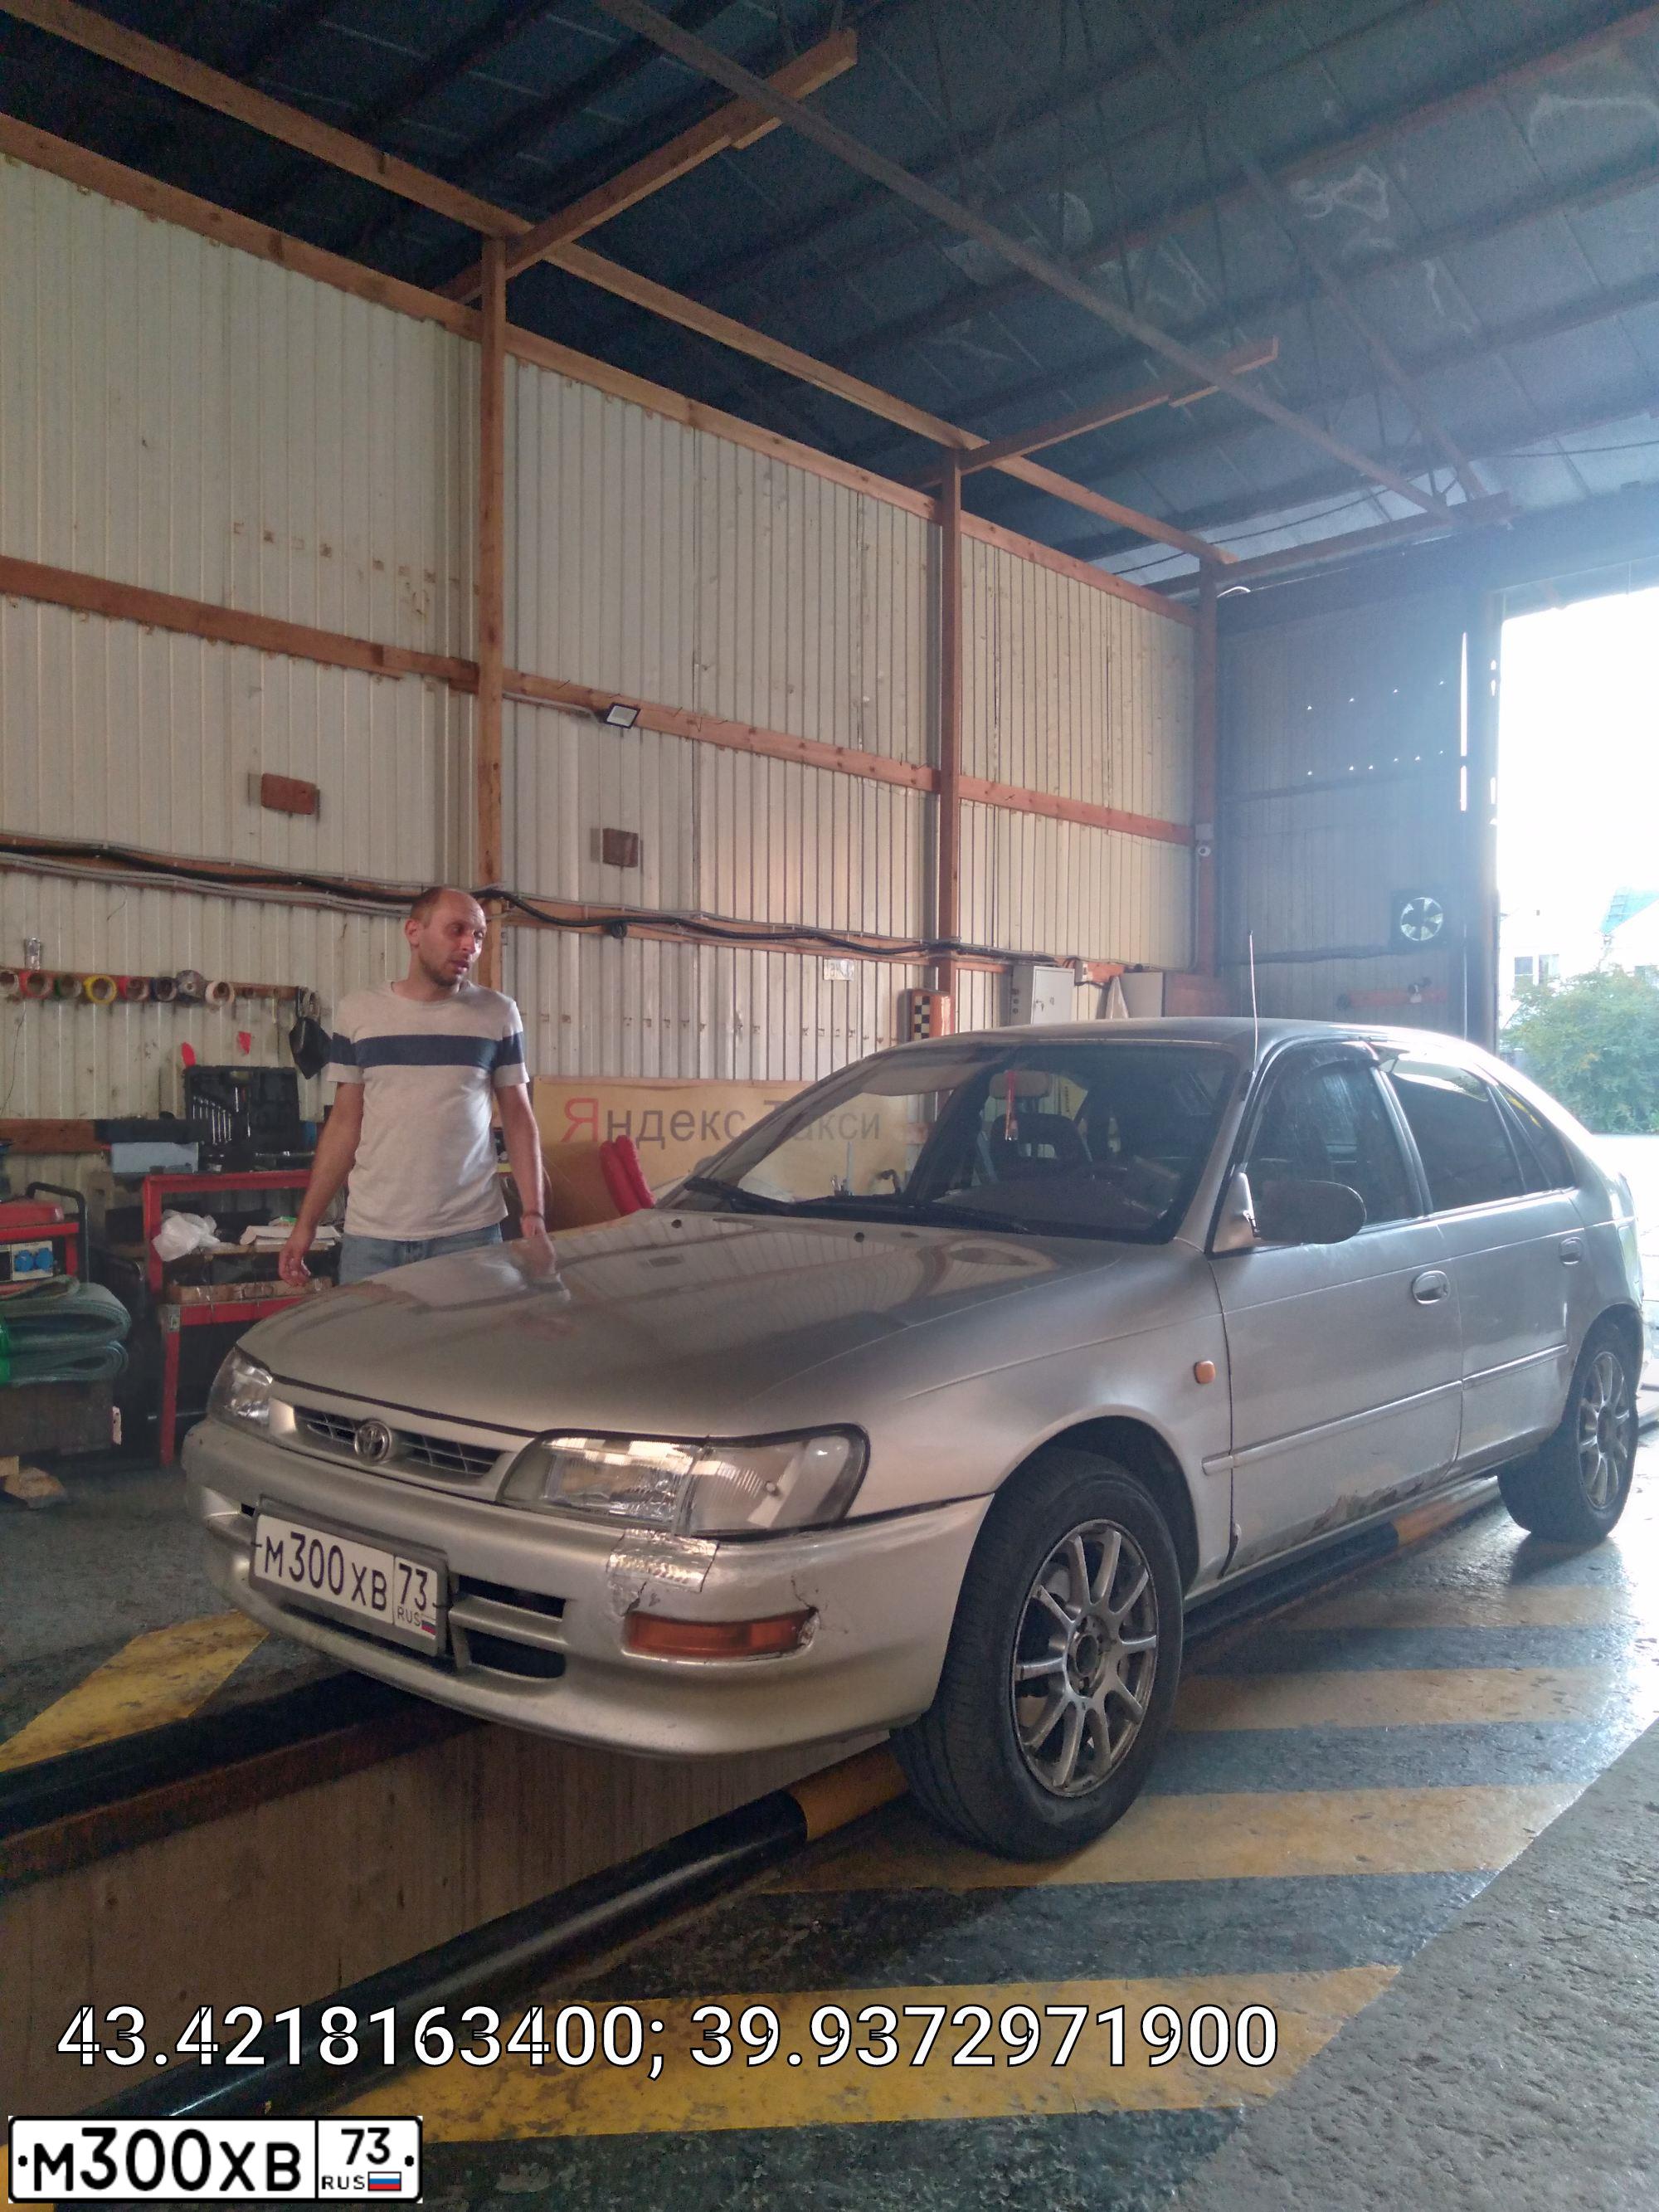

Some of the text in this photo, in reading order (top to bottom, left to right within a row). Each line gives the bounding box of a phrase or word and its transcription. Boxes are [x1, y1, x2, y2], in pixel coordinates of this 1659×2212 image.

[561, 1097, 746, 1150] Яндекс
[399, 1563, 428, 1611] 73
[397, 1606, 421, 1627] RUS
